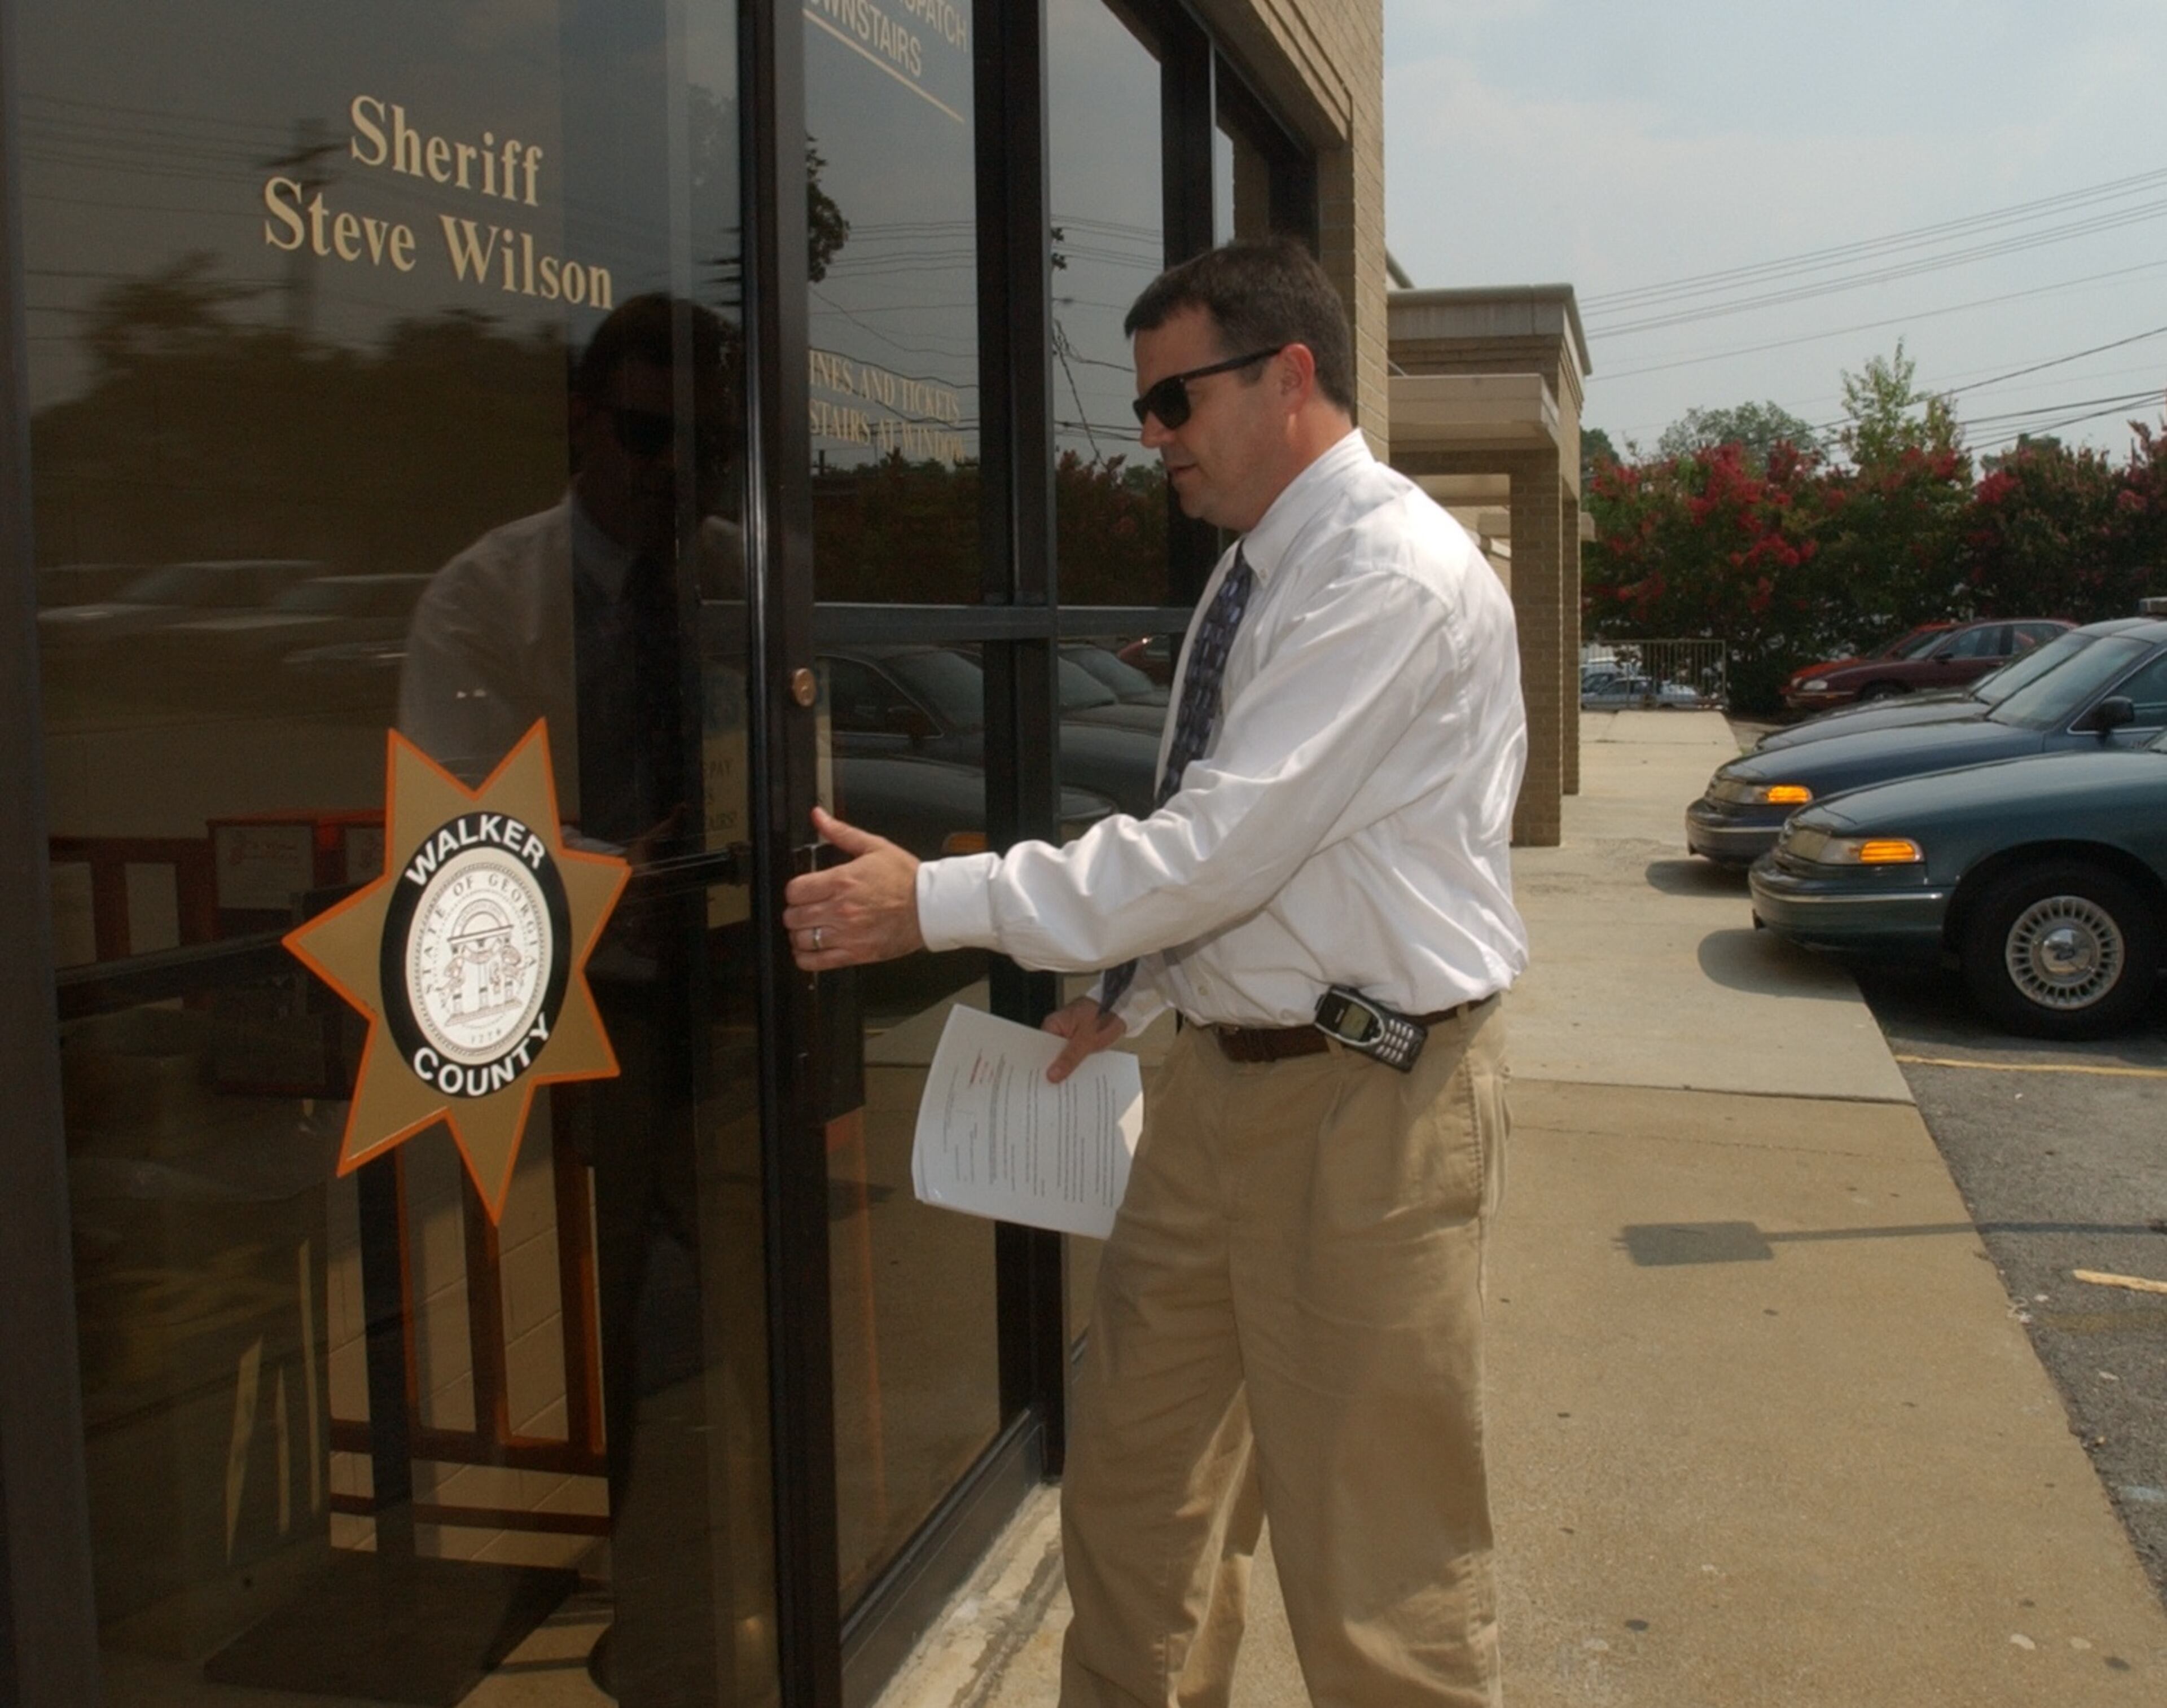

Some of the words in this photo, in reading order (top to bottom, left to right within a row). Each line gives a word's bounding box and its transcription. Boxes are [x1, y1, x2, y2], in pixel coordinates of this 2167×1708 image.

[351, 94, 542, 207] Sheriff
[264, 177, 416, 272] Steve
[440, 214, 613, 310] Wilson
[809, 398, 870, 445] STAIRS
[860, 368, 894, 406] AND
[900, 378, 960, 424] TICKETS
[405, 814, 545, 886] WALKER
[422, 907, 445, 995] STATE
[453, 876, 474, 897] OF
[488, 873, 537, 968] GEORGIA
[414, 1012, 549, 1097] COUNTY
